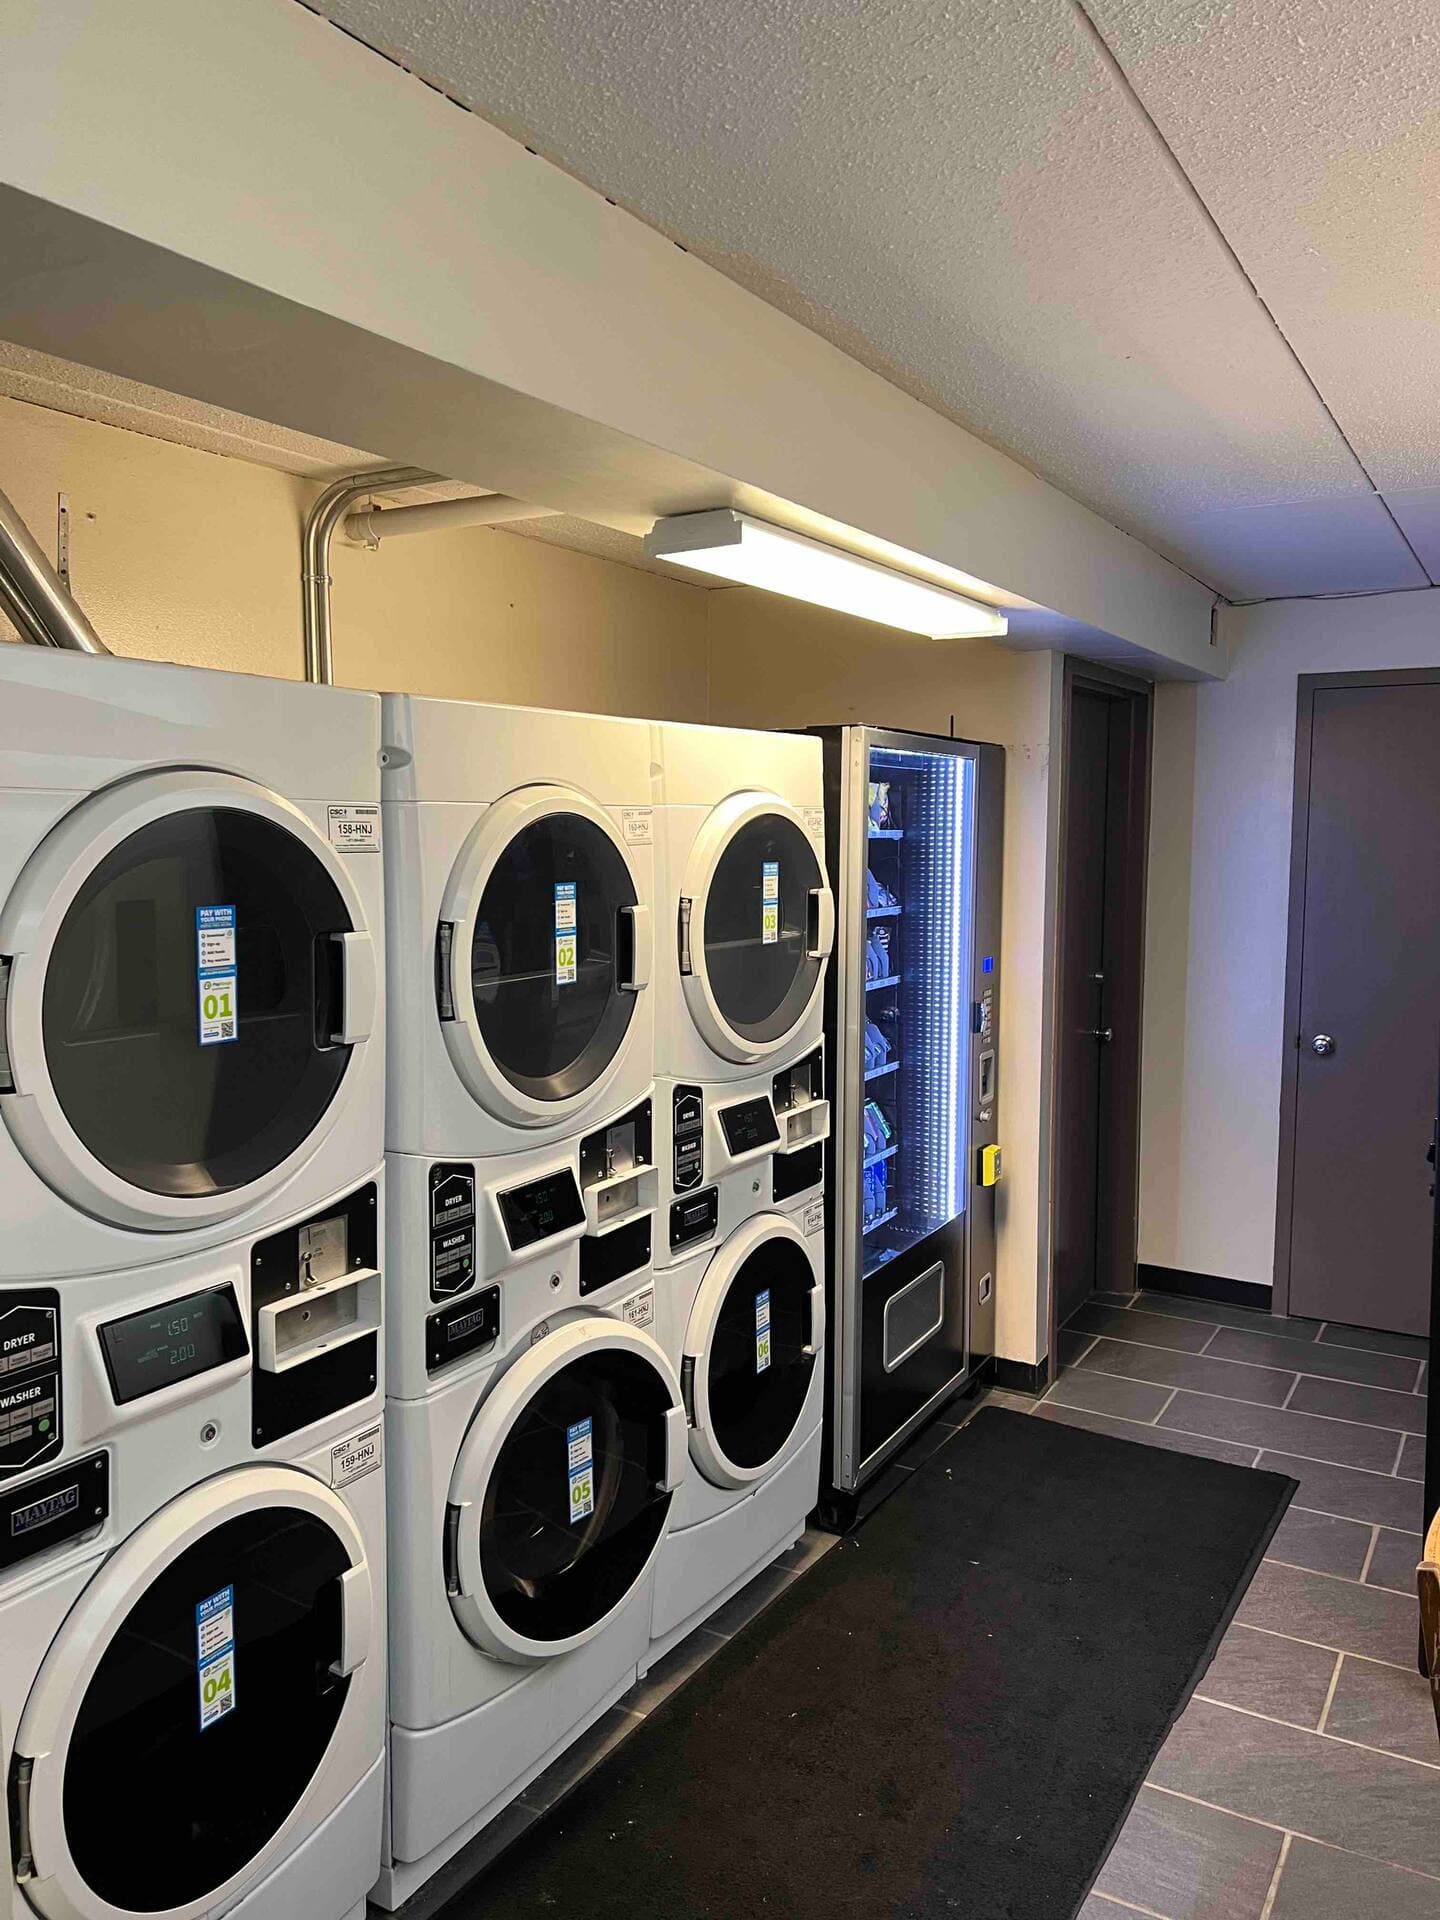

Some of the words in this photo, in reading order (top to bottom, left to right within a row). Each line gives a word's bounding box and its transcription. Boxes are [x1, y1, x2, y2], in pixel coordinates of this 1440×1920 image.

[338, 824, 373, 834] 158-HNJ
[200, 909, 214, 917] PAY
[214, 908, 233, 916] WITH
[764, 914, 776, 930] 03
[558, 946, 574, 967] 02
[203, 993, 233, 1019] 01
[445, 1194, 463, 1206] DRYER
[442, 1234, 466, 1248] WASHER
[3, 1332, 35, 1351] DRYER
[758, 1339, 769, 1358] 06
[169, 1343, 196, 1365] 2.00
[0, 1386, 42, 1409] WASHER
[341, 1444, 375, 1469] 159-HNJ
[572, 1480, 591, 1504] 05
[15, 1490, 75, 1527] MAYTAG
[200, 1600, 212, 1612] PAY
[203, 1668, 232, 1703] 04
